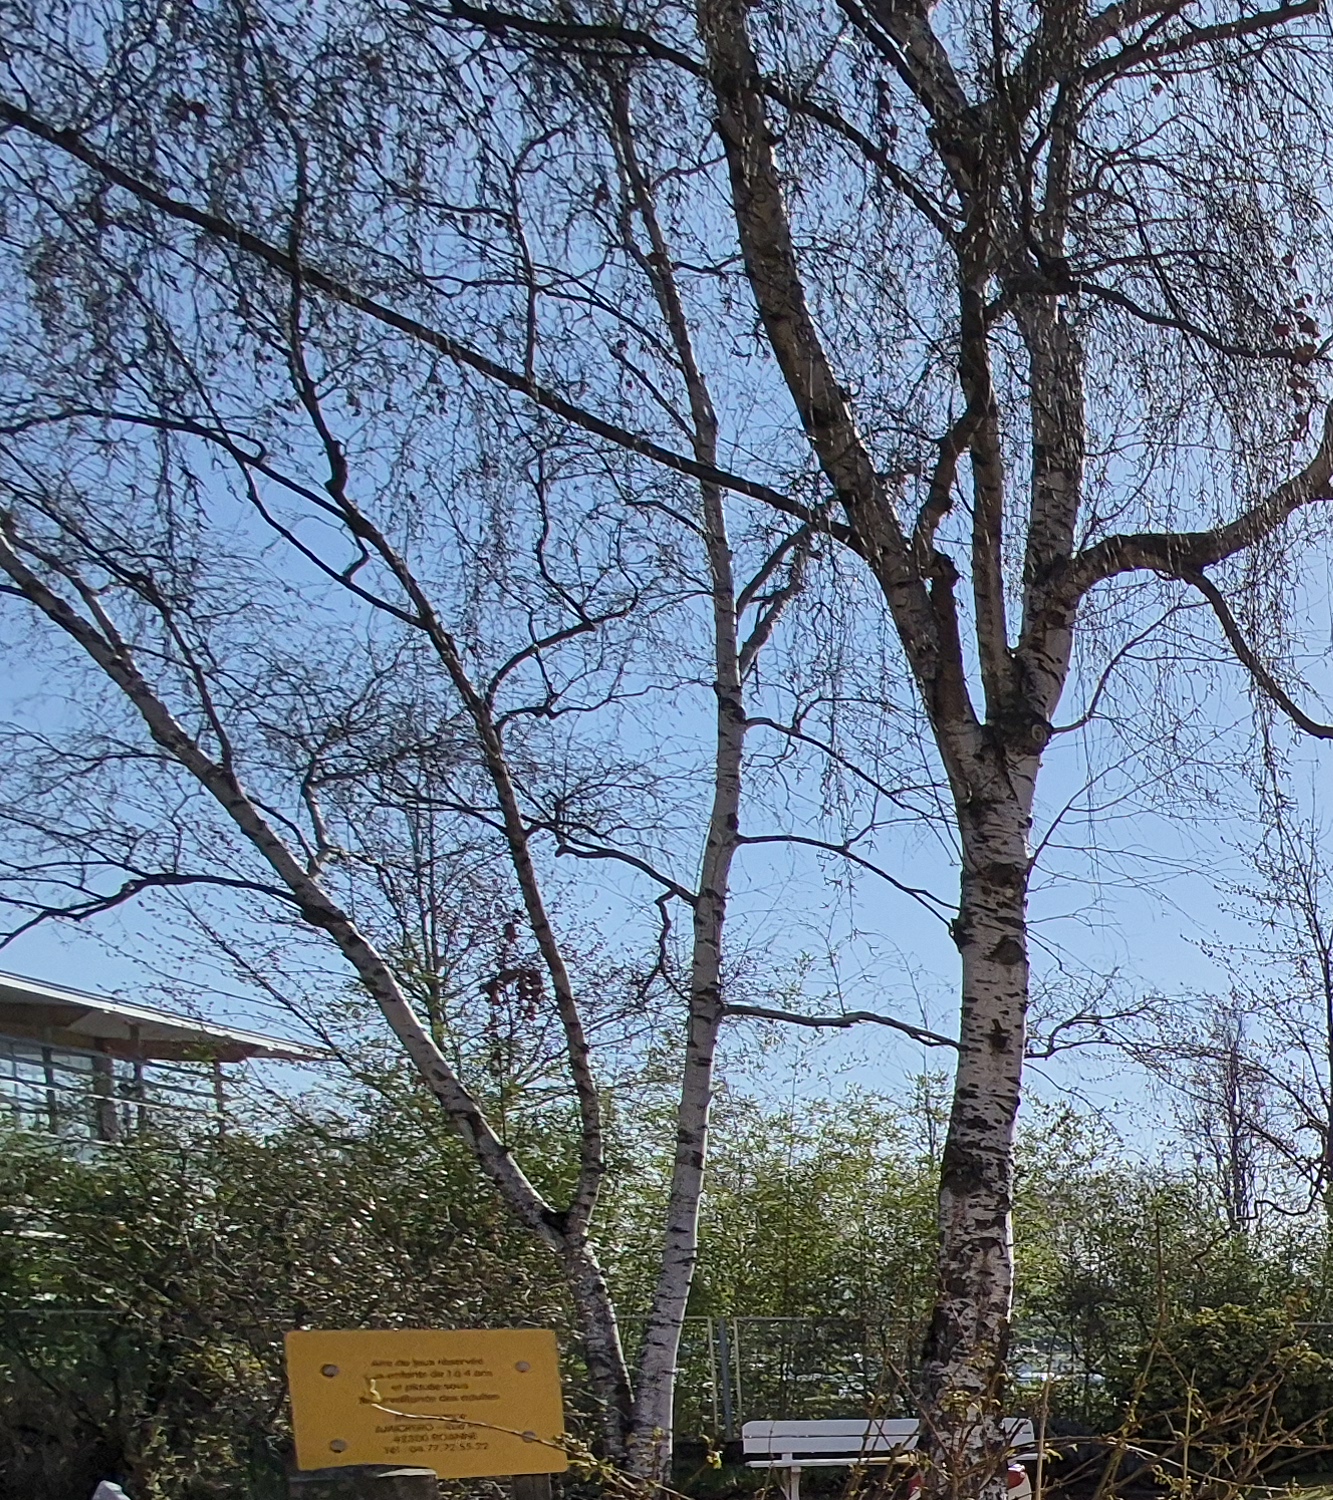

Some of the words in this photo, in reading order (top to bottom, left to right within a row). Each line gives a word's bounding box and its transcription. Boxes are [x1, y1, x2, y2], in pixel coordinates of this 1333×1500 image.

[395, 1359, 410, 1367] de
[412, 1358, 435, 1368] jeux
[474, 1370, 493, 1378] ans
